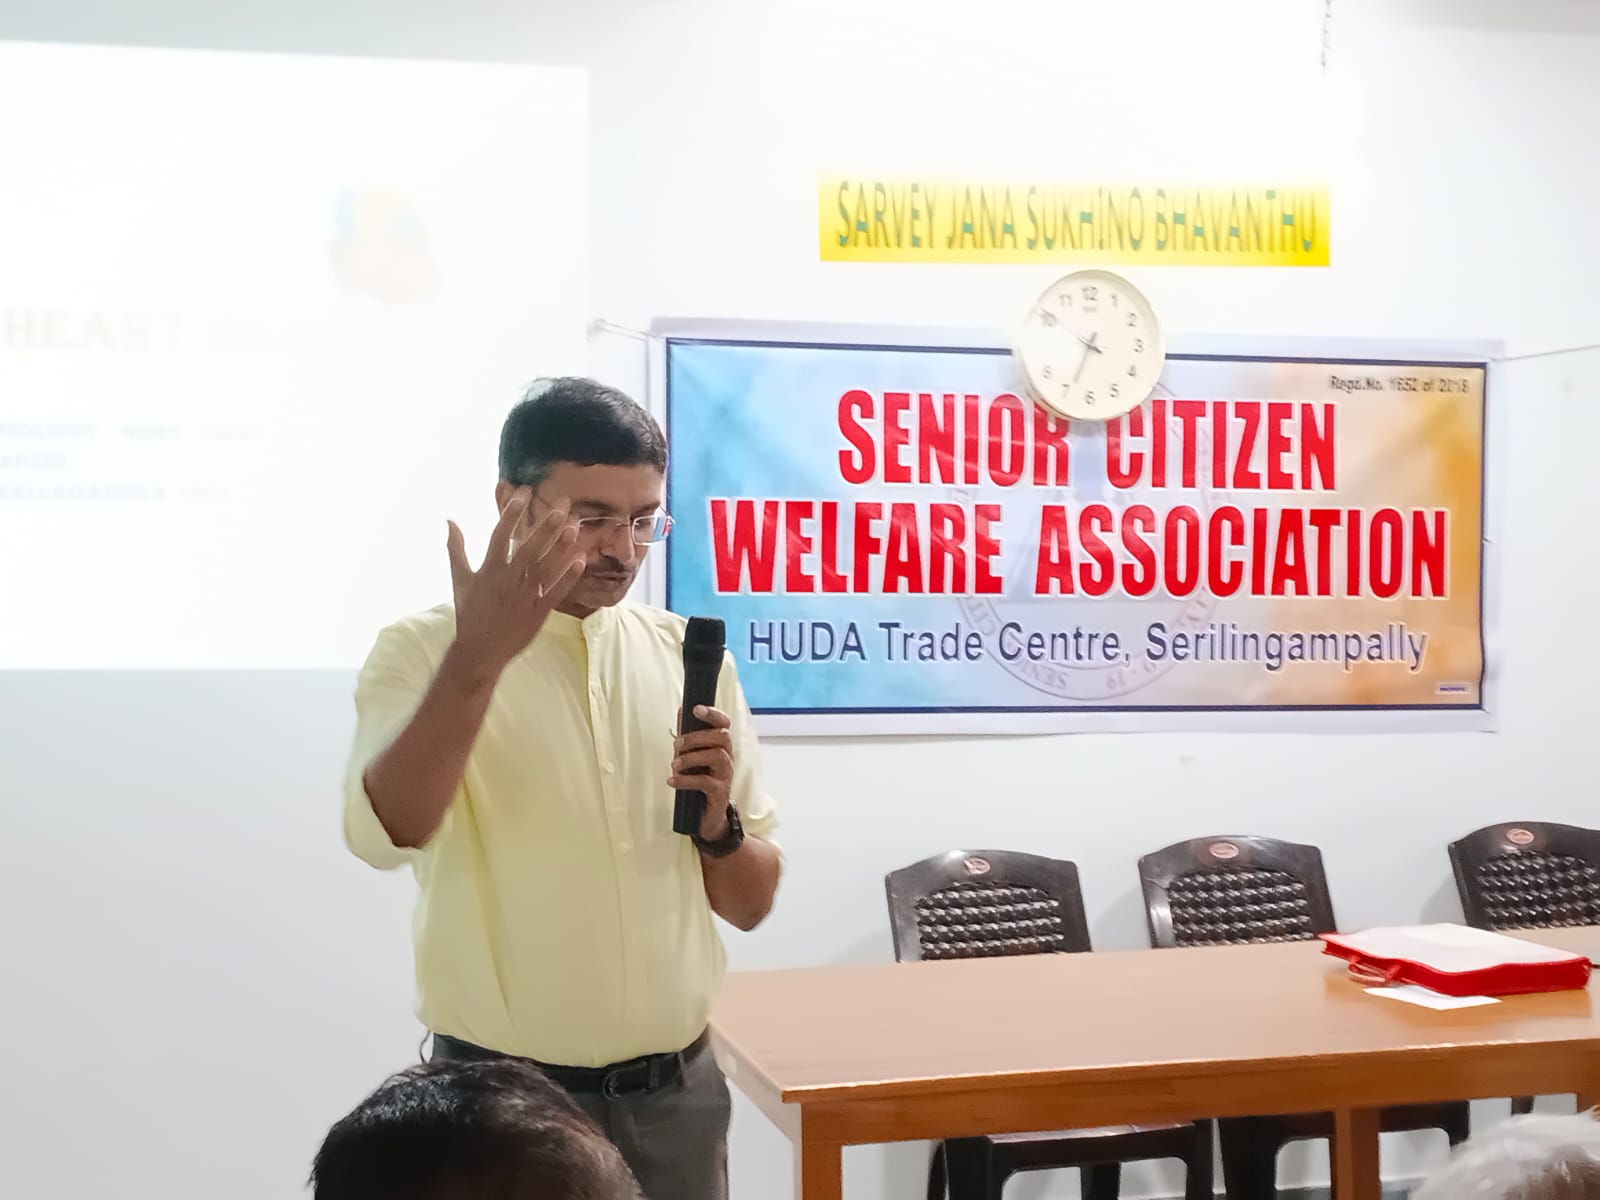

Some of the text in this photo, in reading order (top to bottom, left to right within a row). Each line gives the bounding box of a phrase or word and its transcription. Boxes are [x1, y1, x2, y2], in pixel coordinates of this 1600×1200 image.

[837, 181, 1317, 252] SARVEY JANA SUKHINO BHAVANTHU
[1081, 286, 1098, 301] 12
[1085, 390, 1095, 405] 6
[837, 388, 1336, 491] SENIOR CITIZEN
[710, 499, 1446, 598] WELFARE ASSOCIATION
[750, 621, 1429, 672] HUDA Trade Centre, Serilingampally
